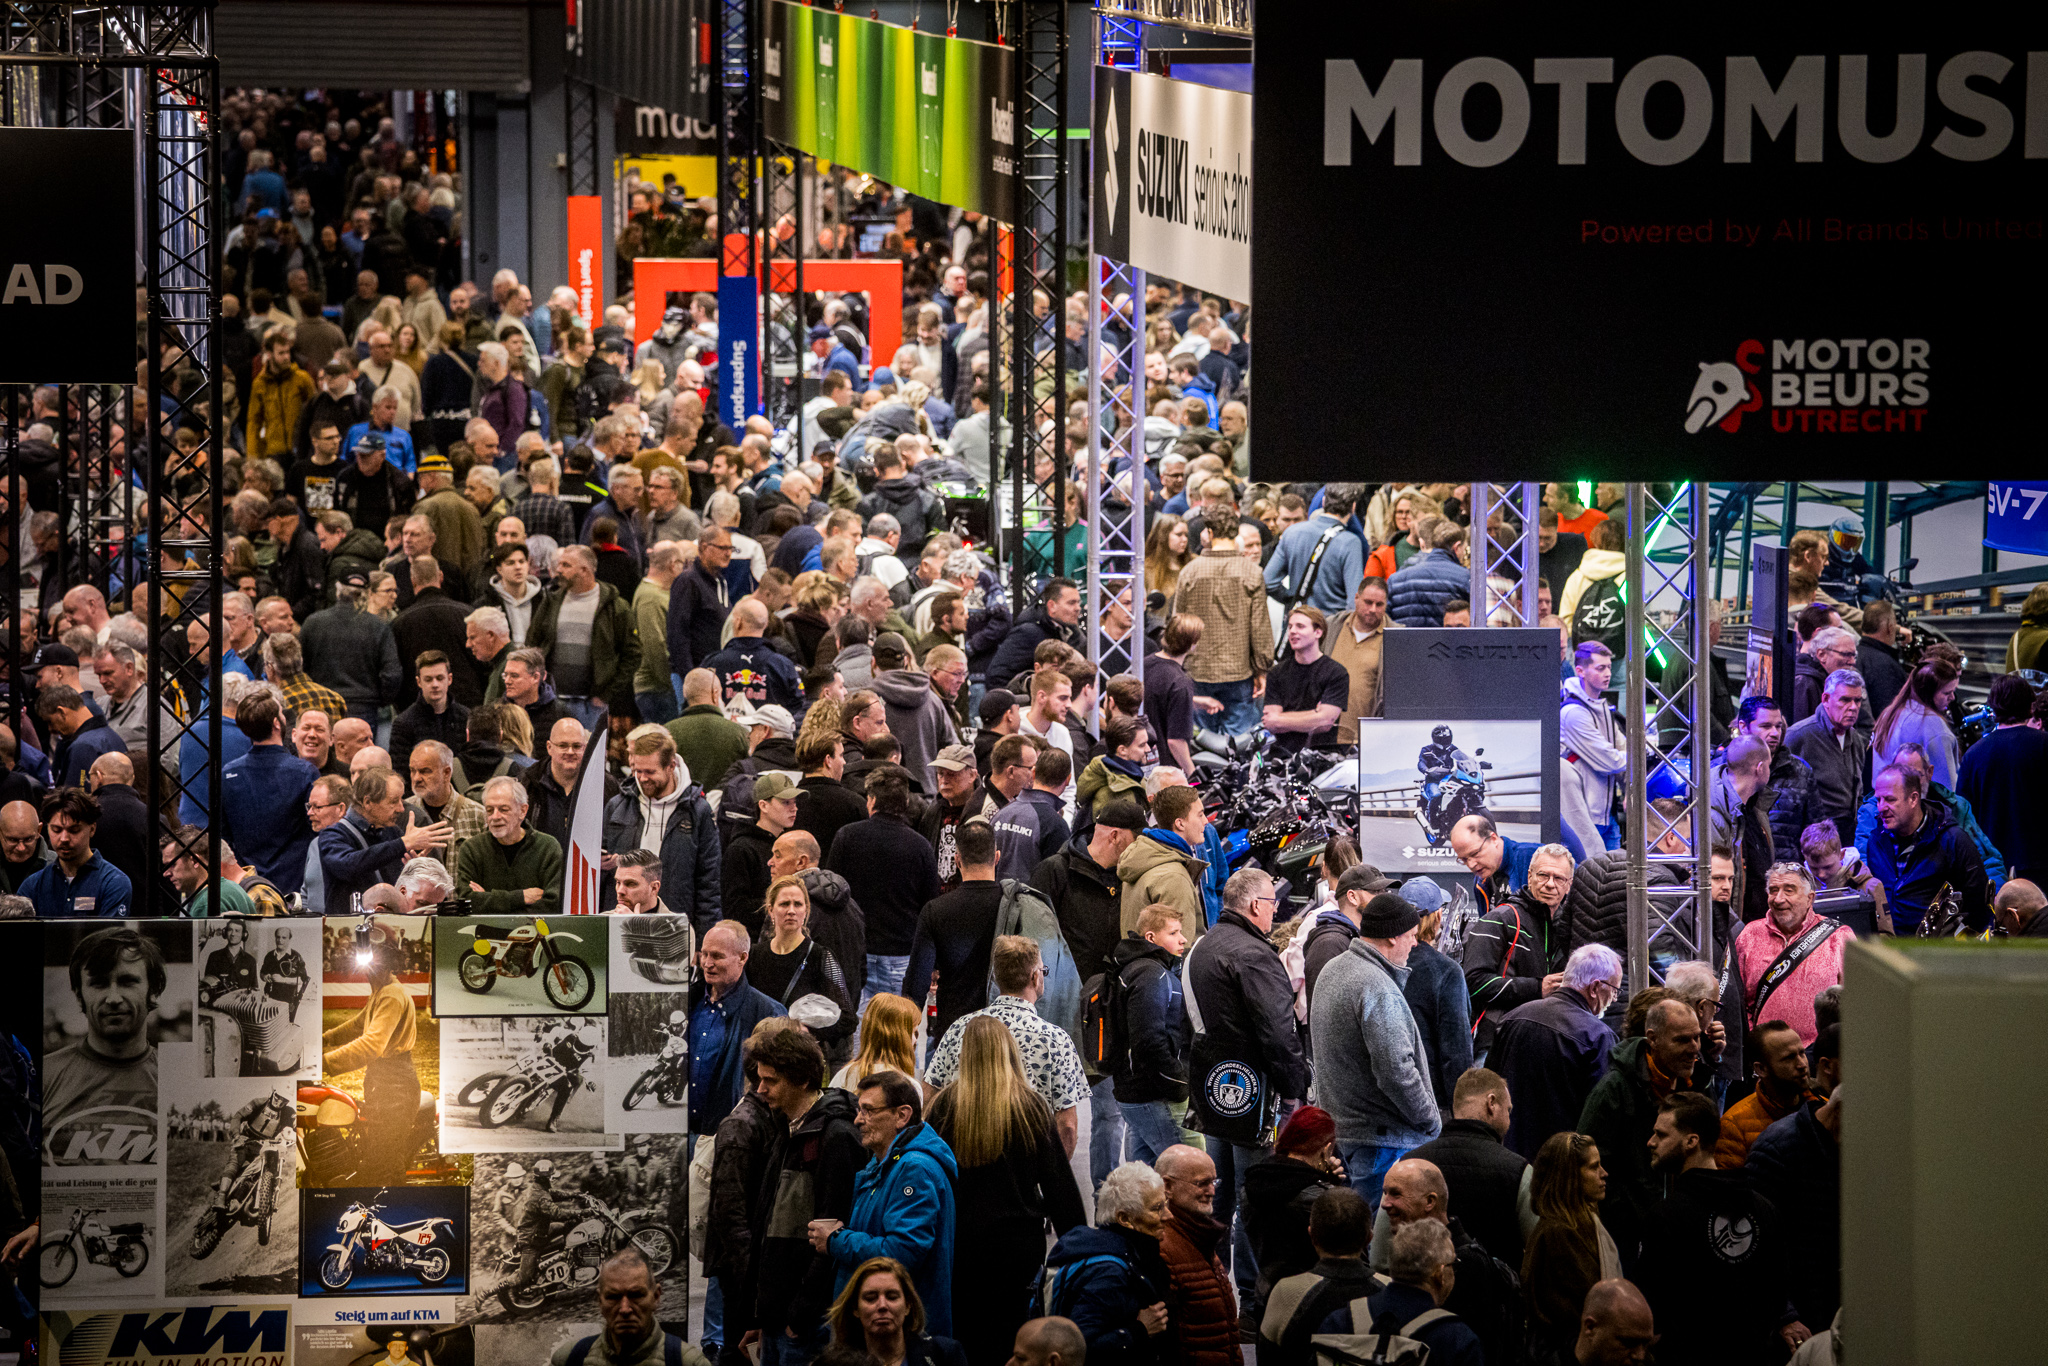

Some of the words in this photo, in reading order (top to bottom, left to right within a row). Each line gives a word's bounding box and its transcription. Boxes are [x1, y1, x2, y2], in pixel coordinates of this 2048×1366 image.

[1137, 128, 1188, 225] SUZUKI
[1194, 147, 1229, 239] serious
[1231, 152, 1251, 245] abo
[1581, 219, 1712, 244] Powered
[1725, 219, 1760, 247] by
[1772, 218, 1811, 242] All
[1824, 217, 1929, 242] Brands
[1942, 216, 2044, 241] United
[2, 264, 83, 305] AD
[1772, 339, 1931, 370] MOTOR
[730, 340, 747, 429] Supersport
[1772, 373, 1931, 406] BEURS
[1772, 409, 1928, 433] UTRECHT
[1455, 644, 1548, 660] SUZUKI
[1001, 823, 1033, 837] SUZUKI
[1417, 847, 1458, 857] SUZU
[56, 1179, 72, 1187] und
[73, 1178, 107, 1188] Leistung
[109, 1179, 123, 1187] wie
[125, 1178, 138, 1186] die
[547, 1265, 565, 1282] 70
[335, 1310, 366, 1324] Steig
[368, 1311, 388, 1321] um
[390, 1310, 411, 1321] auf
[413, 1309, 440, 1321] KTM
[107, 1304, 288, 1358] KTM
